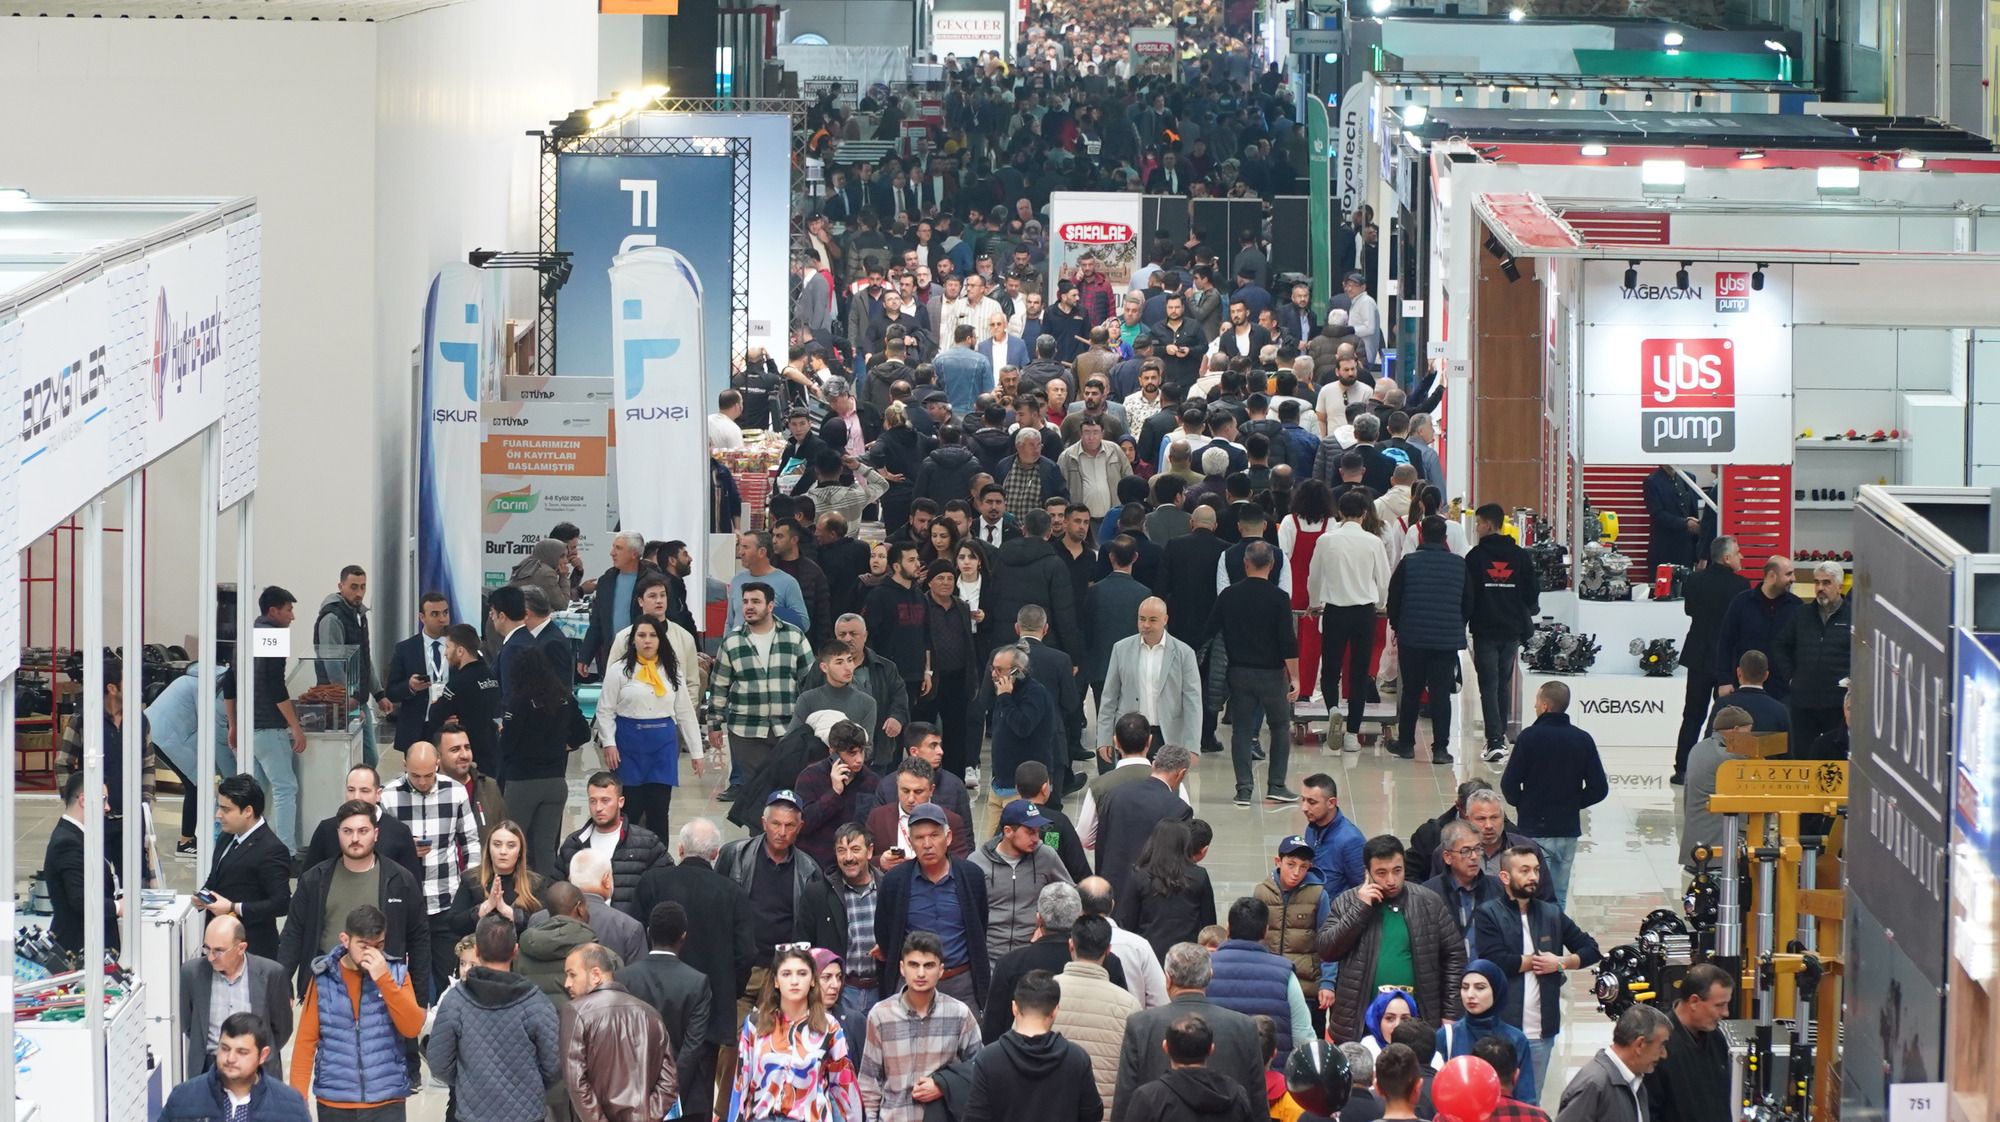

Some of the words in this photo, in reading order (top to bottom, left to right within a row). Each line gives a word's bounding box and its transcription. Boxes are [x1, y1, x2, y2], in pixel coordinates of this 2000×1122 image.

[937, 19, 1001, 32] GENÇLER
[1065, 225, 1126, 241] ŞAKALAK
[1719, 274, 1745, 295] ybs
[1620, 283, 1702, 300] YAĞBASAN
[1719, 299, 1745, 311] pump
[1653, 342, 1722, 402] ybs
[530, 390, 555, 399] TÜYAP
[502, 416, 529, 427] TÜYAP
[1654, 416, 1722, 447] pump
[503, 440, 581, 449] FUARLARIMIZIN
[506, 449, 521, 459] ÖN
[524, 451, 576, 460] KAYITLARI
[508, 462, 575, 472] BAŞLAMIŞTIR
[495, 498, 529, 510] Tarım
[521, 534, 541, 544] 2024
[262, 637, 278, 647] 759
[1579, 697, 1664, 714] YAĞBASAN
[1873, 628, 1943, 794] UYSAL
[1870, 788, 1944, 901] HYDRAULIC
[1908, 1098, 1931, 1110] 751
